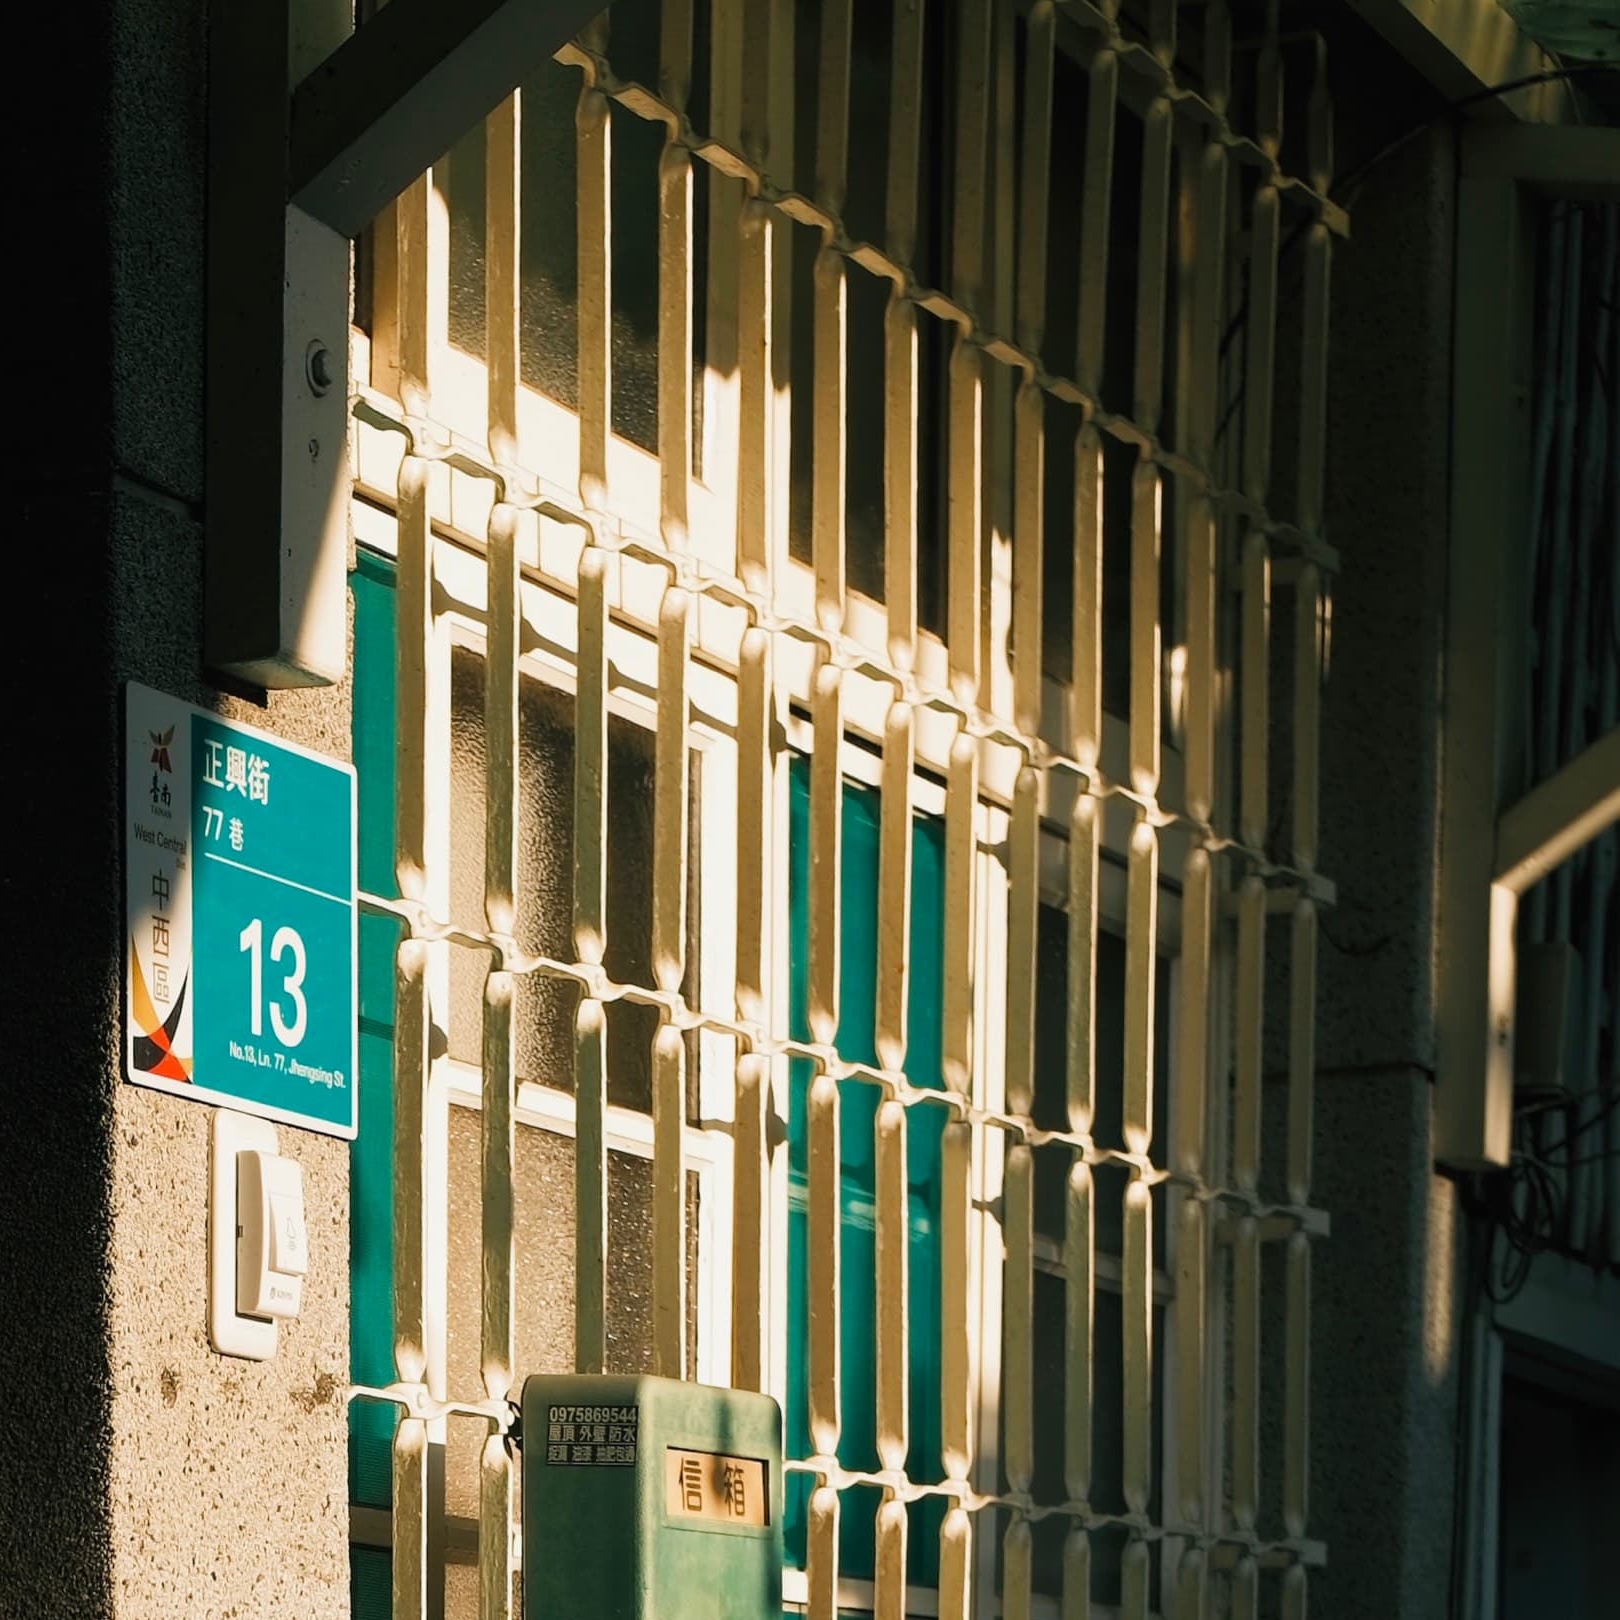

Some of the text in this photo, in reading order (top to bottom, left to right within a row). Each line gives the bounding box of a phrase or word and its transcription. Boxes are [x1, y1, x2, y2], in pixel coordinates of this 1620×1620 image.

[202, 739, 270, 806] 正興街
[134, 822, 187, 855] West Central
[202, 805, 224, 841] 77
[151, 868, 170, 1004] 中西區
[239, 917, 307, 1048] 13
[229, 1040, 256, 1067] No.13,
[258, 1048, 272, 1068] Ln.
[334, 1070, 346, 1089] St.
[549, 1406, 637, 1423] 0975869544
[609, 1426, 636, 1443] 防水
[678, 1456, 746, 1517] 信箱
